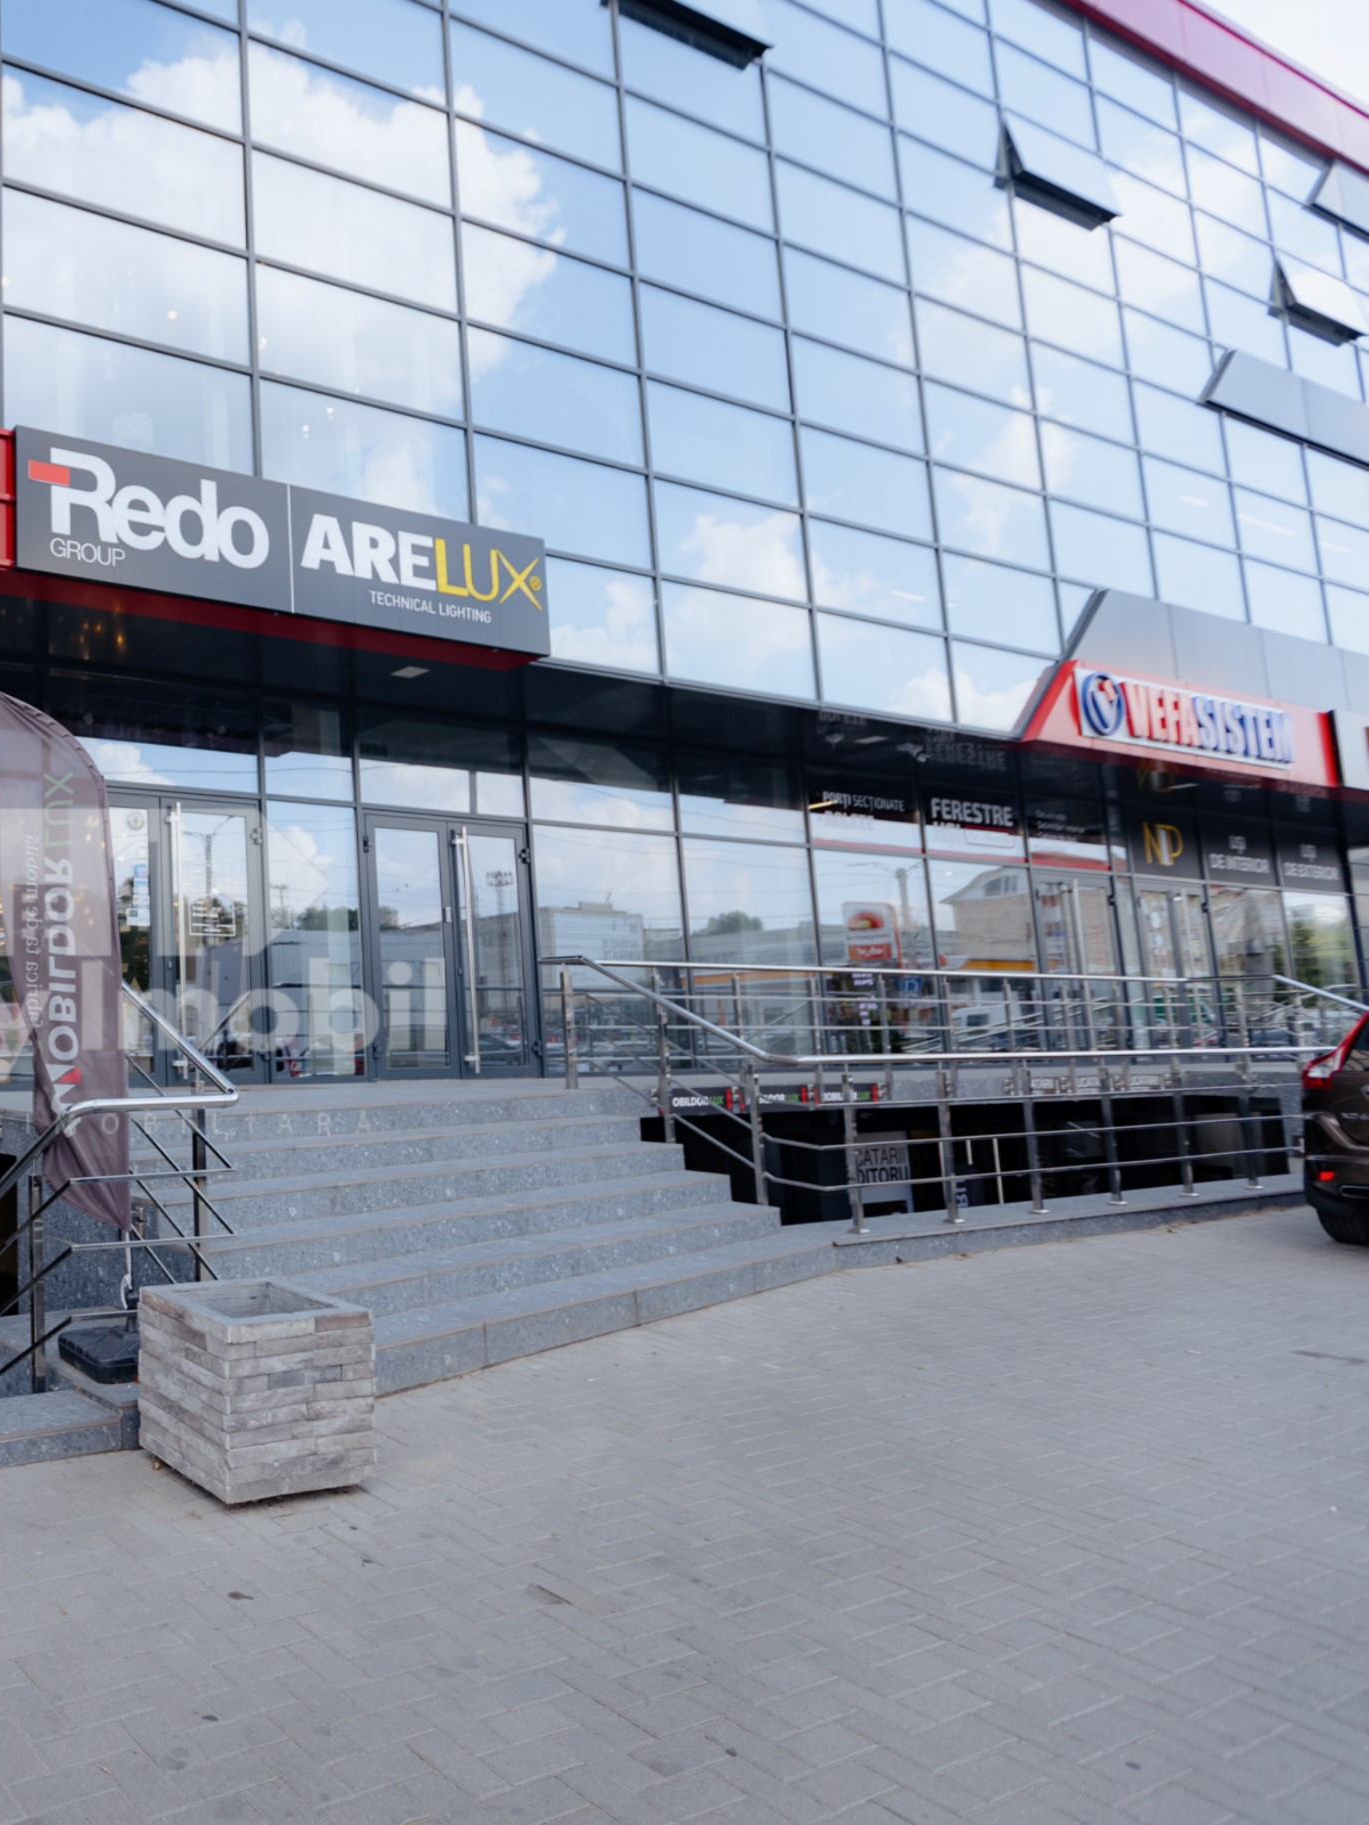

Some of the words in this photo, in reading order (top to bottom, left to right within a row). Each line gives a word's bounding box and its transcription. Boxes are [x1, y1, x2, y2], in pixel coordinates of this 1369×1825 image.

[28, 447, 269, 570] Redo
[49, 537, 126, 567] GROUP
[369, 590, 435, 614] TECHNICAL
[438, 603, 492, 624] LIGHTING
[1119, 682, 1293, 763] VEFASISTEM
[930, 797, 1014, 827] FERESTRE
